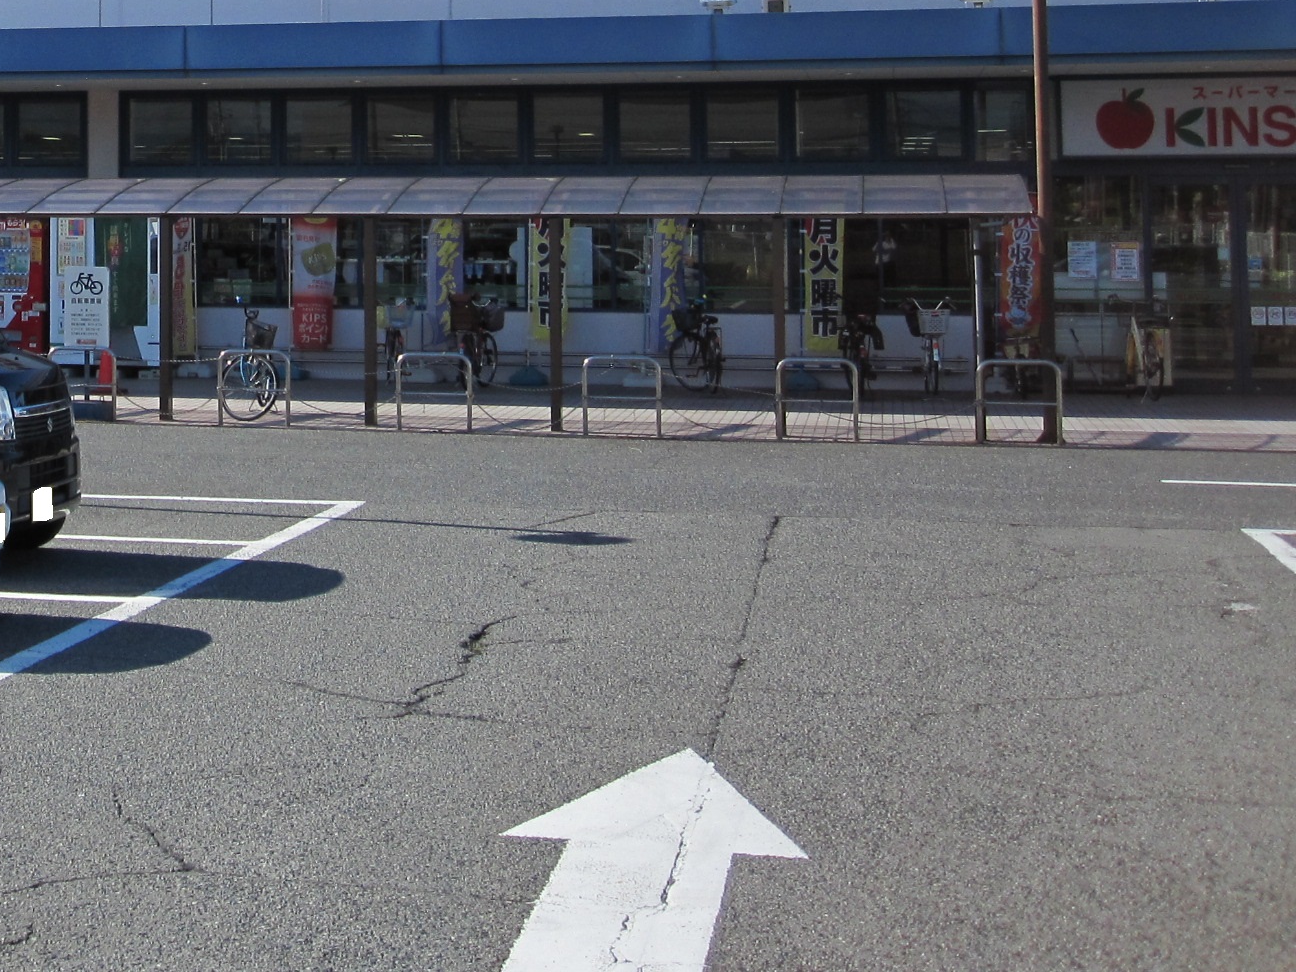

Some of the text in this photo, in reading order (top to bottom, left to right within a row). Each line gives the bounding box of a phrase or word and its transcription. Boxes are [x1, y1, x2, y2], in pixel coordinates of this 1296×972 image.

[302, 313, 327, 323] KIPS
[300, 334, 328, 344] カード
